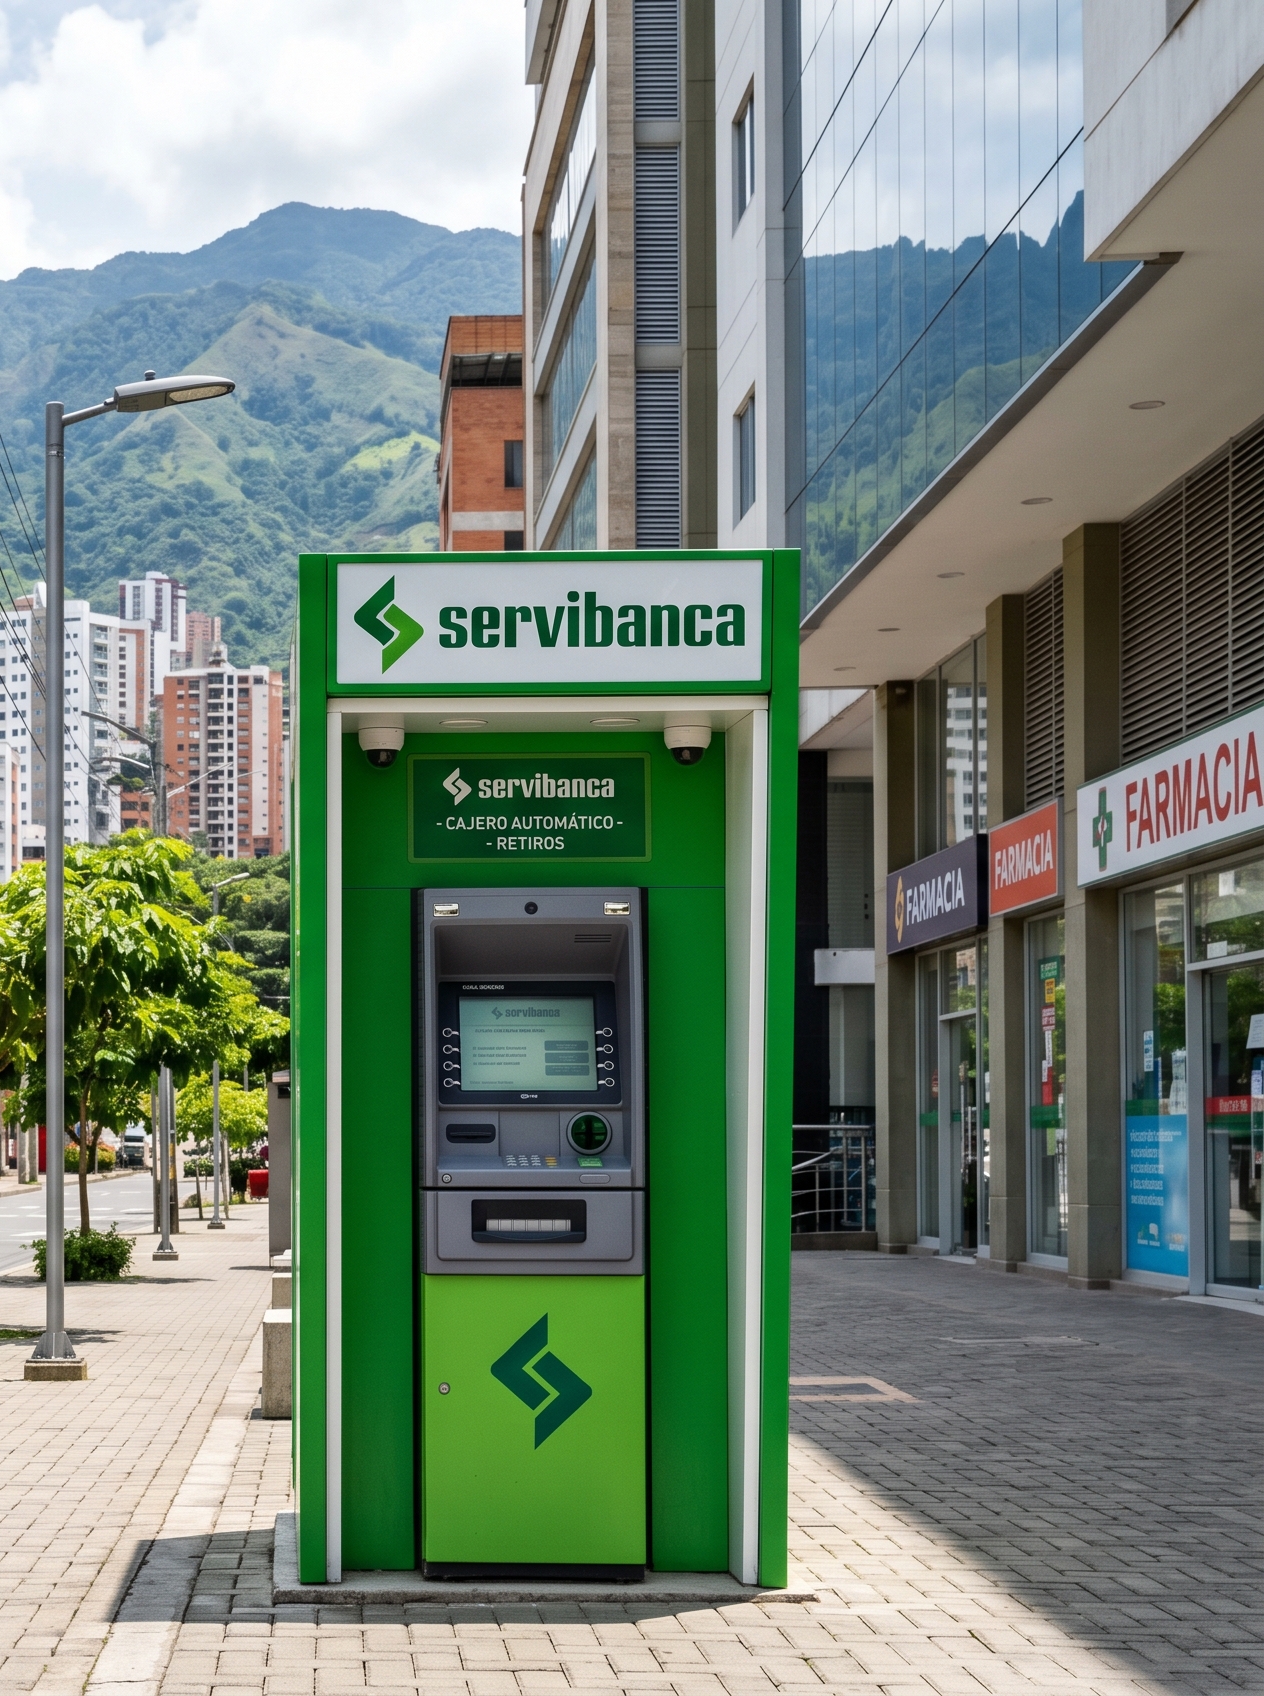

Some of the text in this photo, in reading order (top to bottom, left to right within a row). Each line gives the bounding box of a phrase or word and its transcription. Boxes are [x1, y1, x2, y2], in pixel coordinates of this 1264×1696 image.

[439, 590, 746, 649] servibanca
[478, 773, 615, 799] servibanca
[1125, 731, 1264, 853] FARMACIA
[445, 816, 508, 830] CAJERO
[511, 812, 614, 830] AUTOMÁTICO
[496, 836, 565, 850] RETIROS
[994, 829, 1054, 890] FARMACIA
[906, 867, 965, 926] FARMACIA
